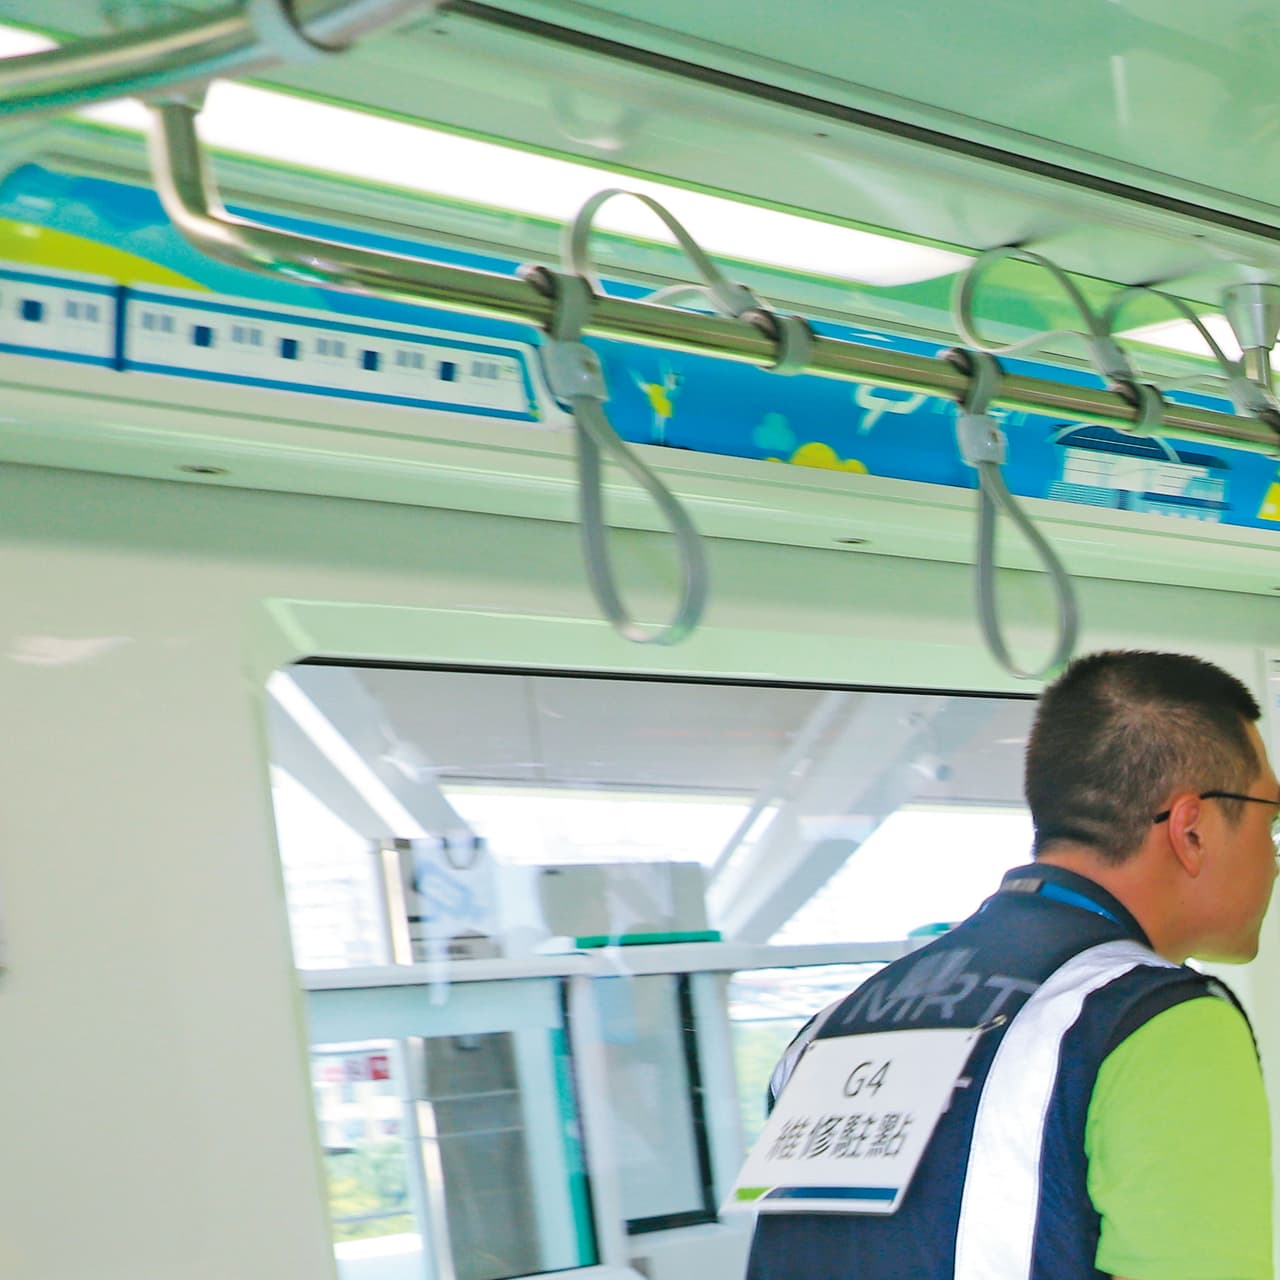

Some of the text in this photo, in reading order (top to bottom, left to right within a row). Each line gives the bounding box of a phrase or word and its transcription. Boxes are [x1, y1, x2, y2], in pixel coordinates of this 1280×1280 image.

[842, 973, 1041, 1026] MRT
[843, 1060, 891, 1098] G4
[765, 1112, 913, 1160] 維修駐點
